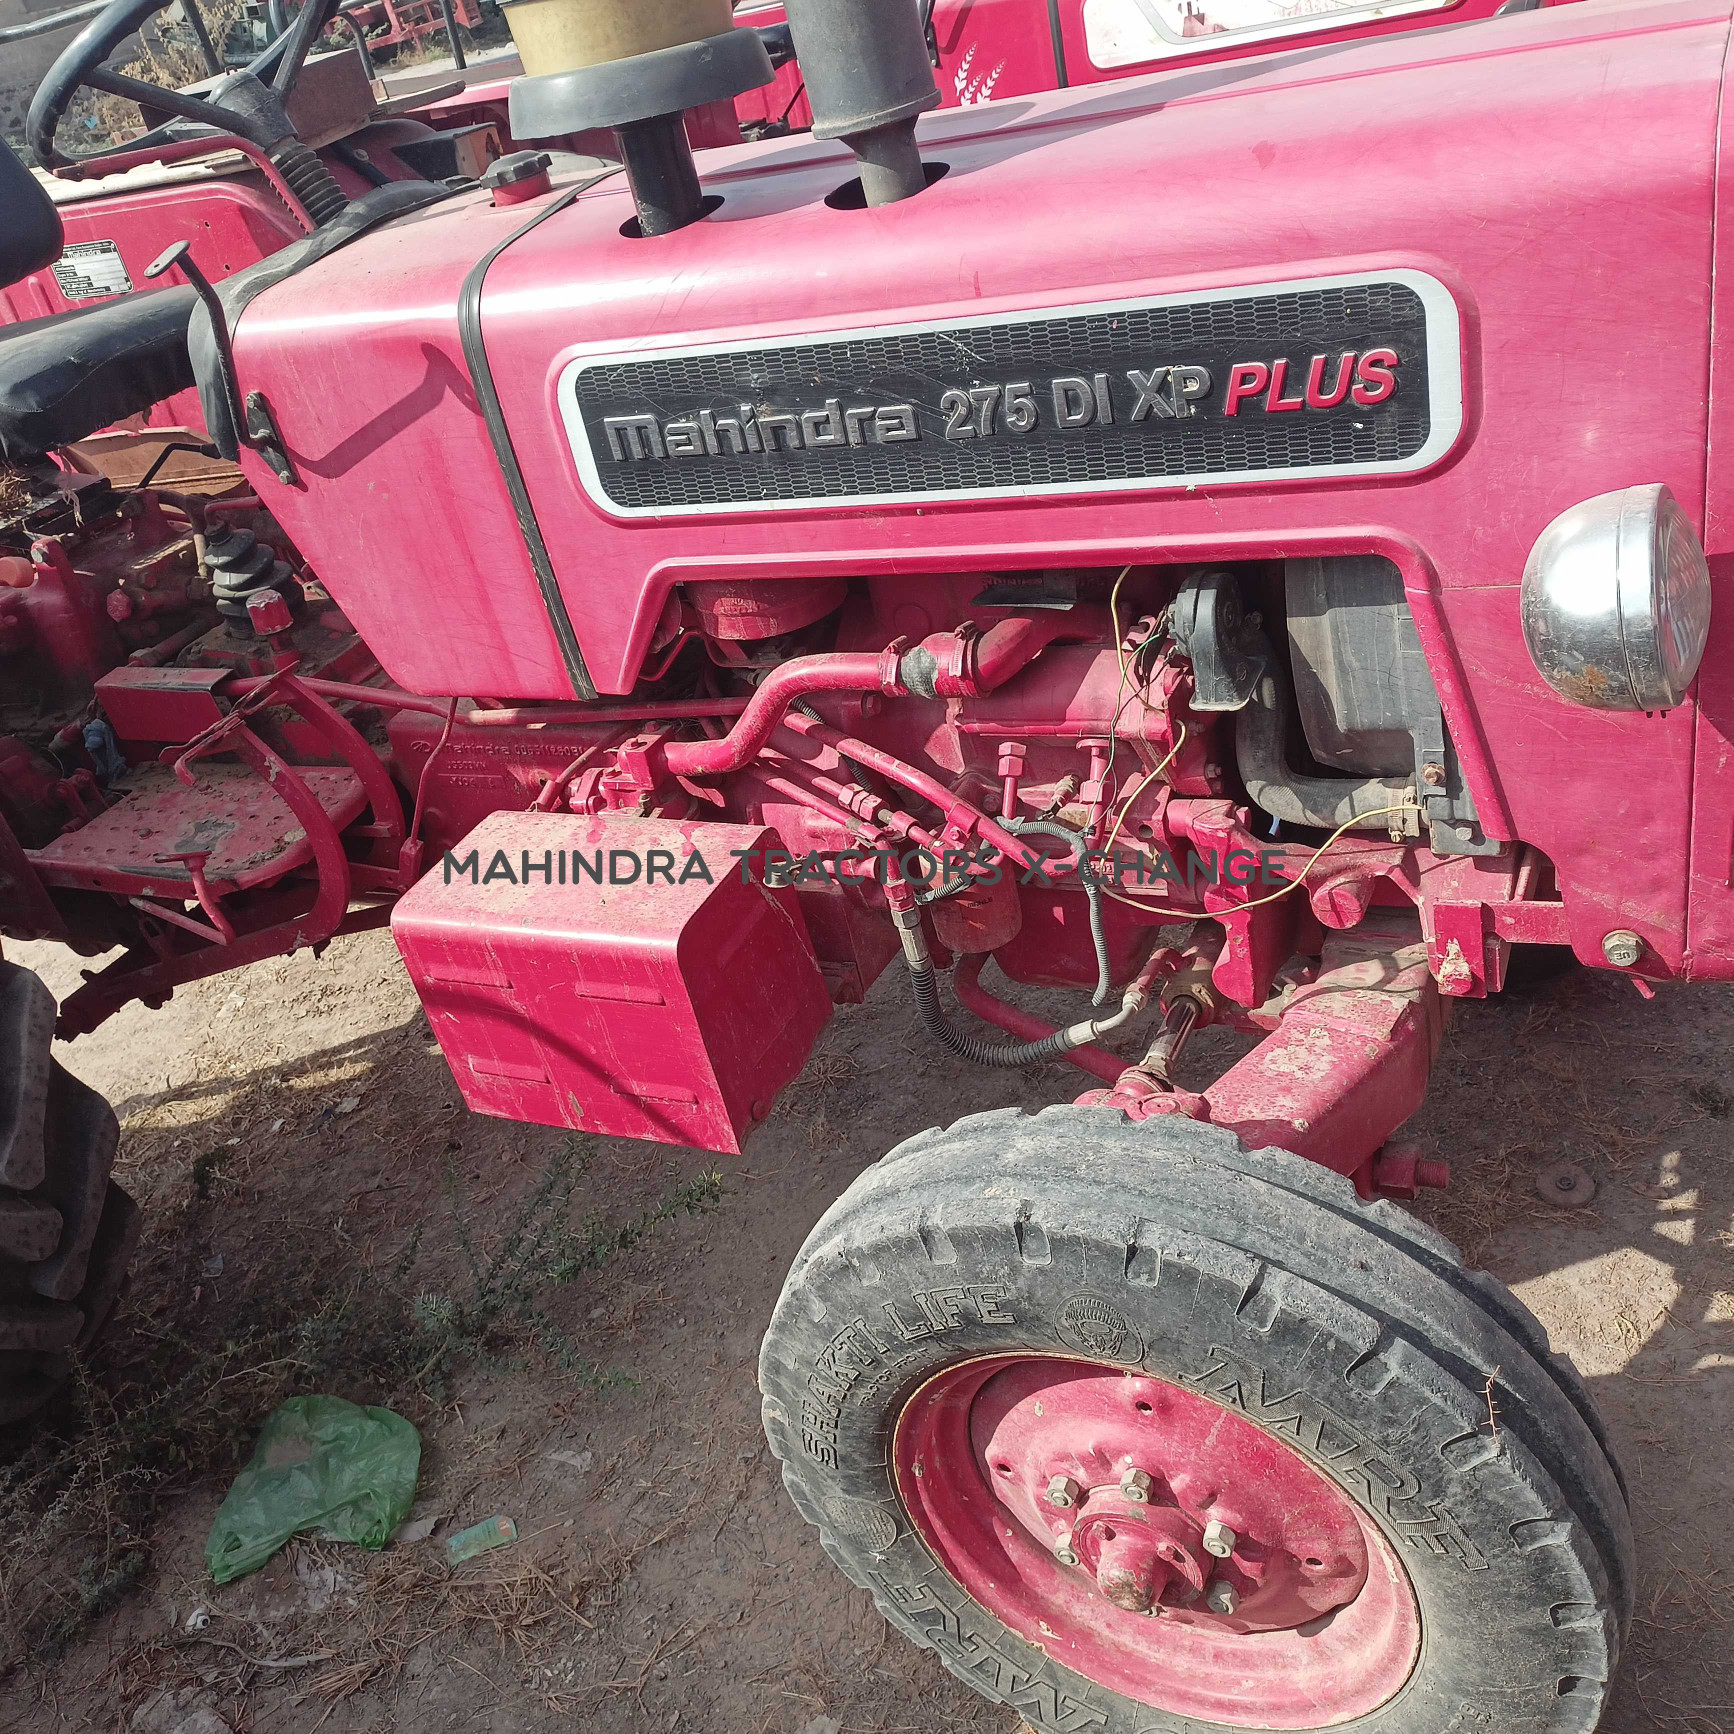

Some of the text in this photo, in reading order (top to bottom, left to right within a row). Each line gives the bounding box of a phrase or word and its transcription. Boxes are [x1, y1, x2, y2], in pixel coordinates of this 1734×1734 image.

[603, 347, 1401, 462] Mahindra 275 DI XP PLUS
[801, 1284, 1018, 1470] SHAKTI LIFE
[1178, 1346, 1490, 1572] MRF
